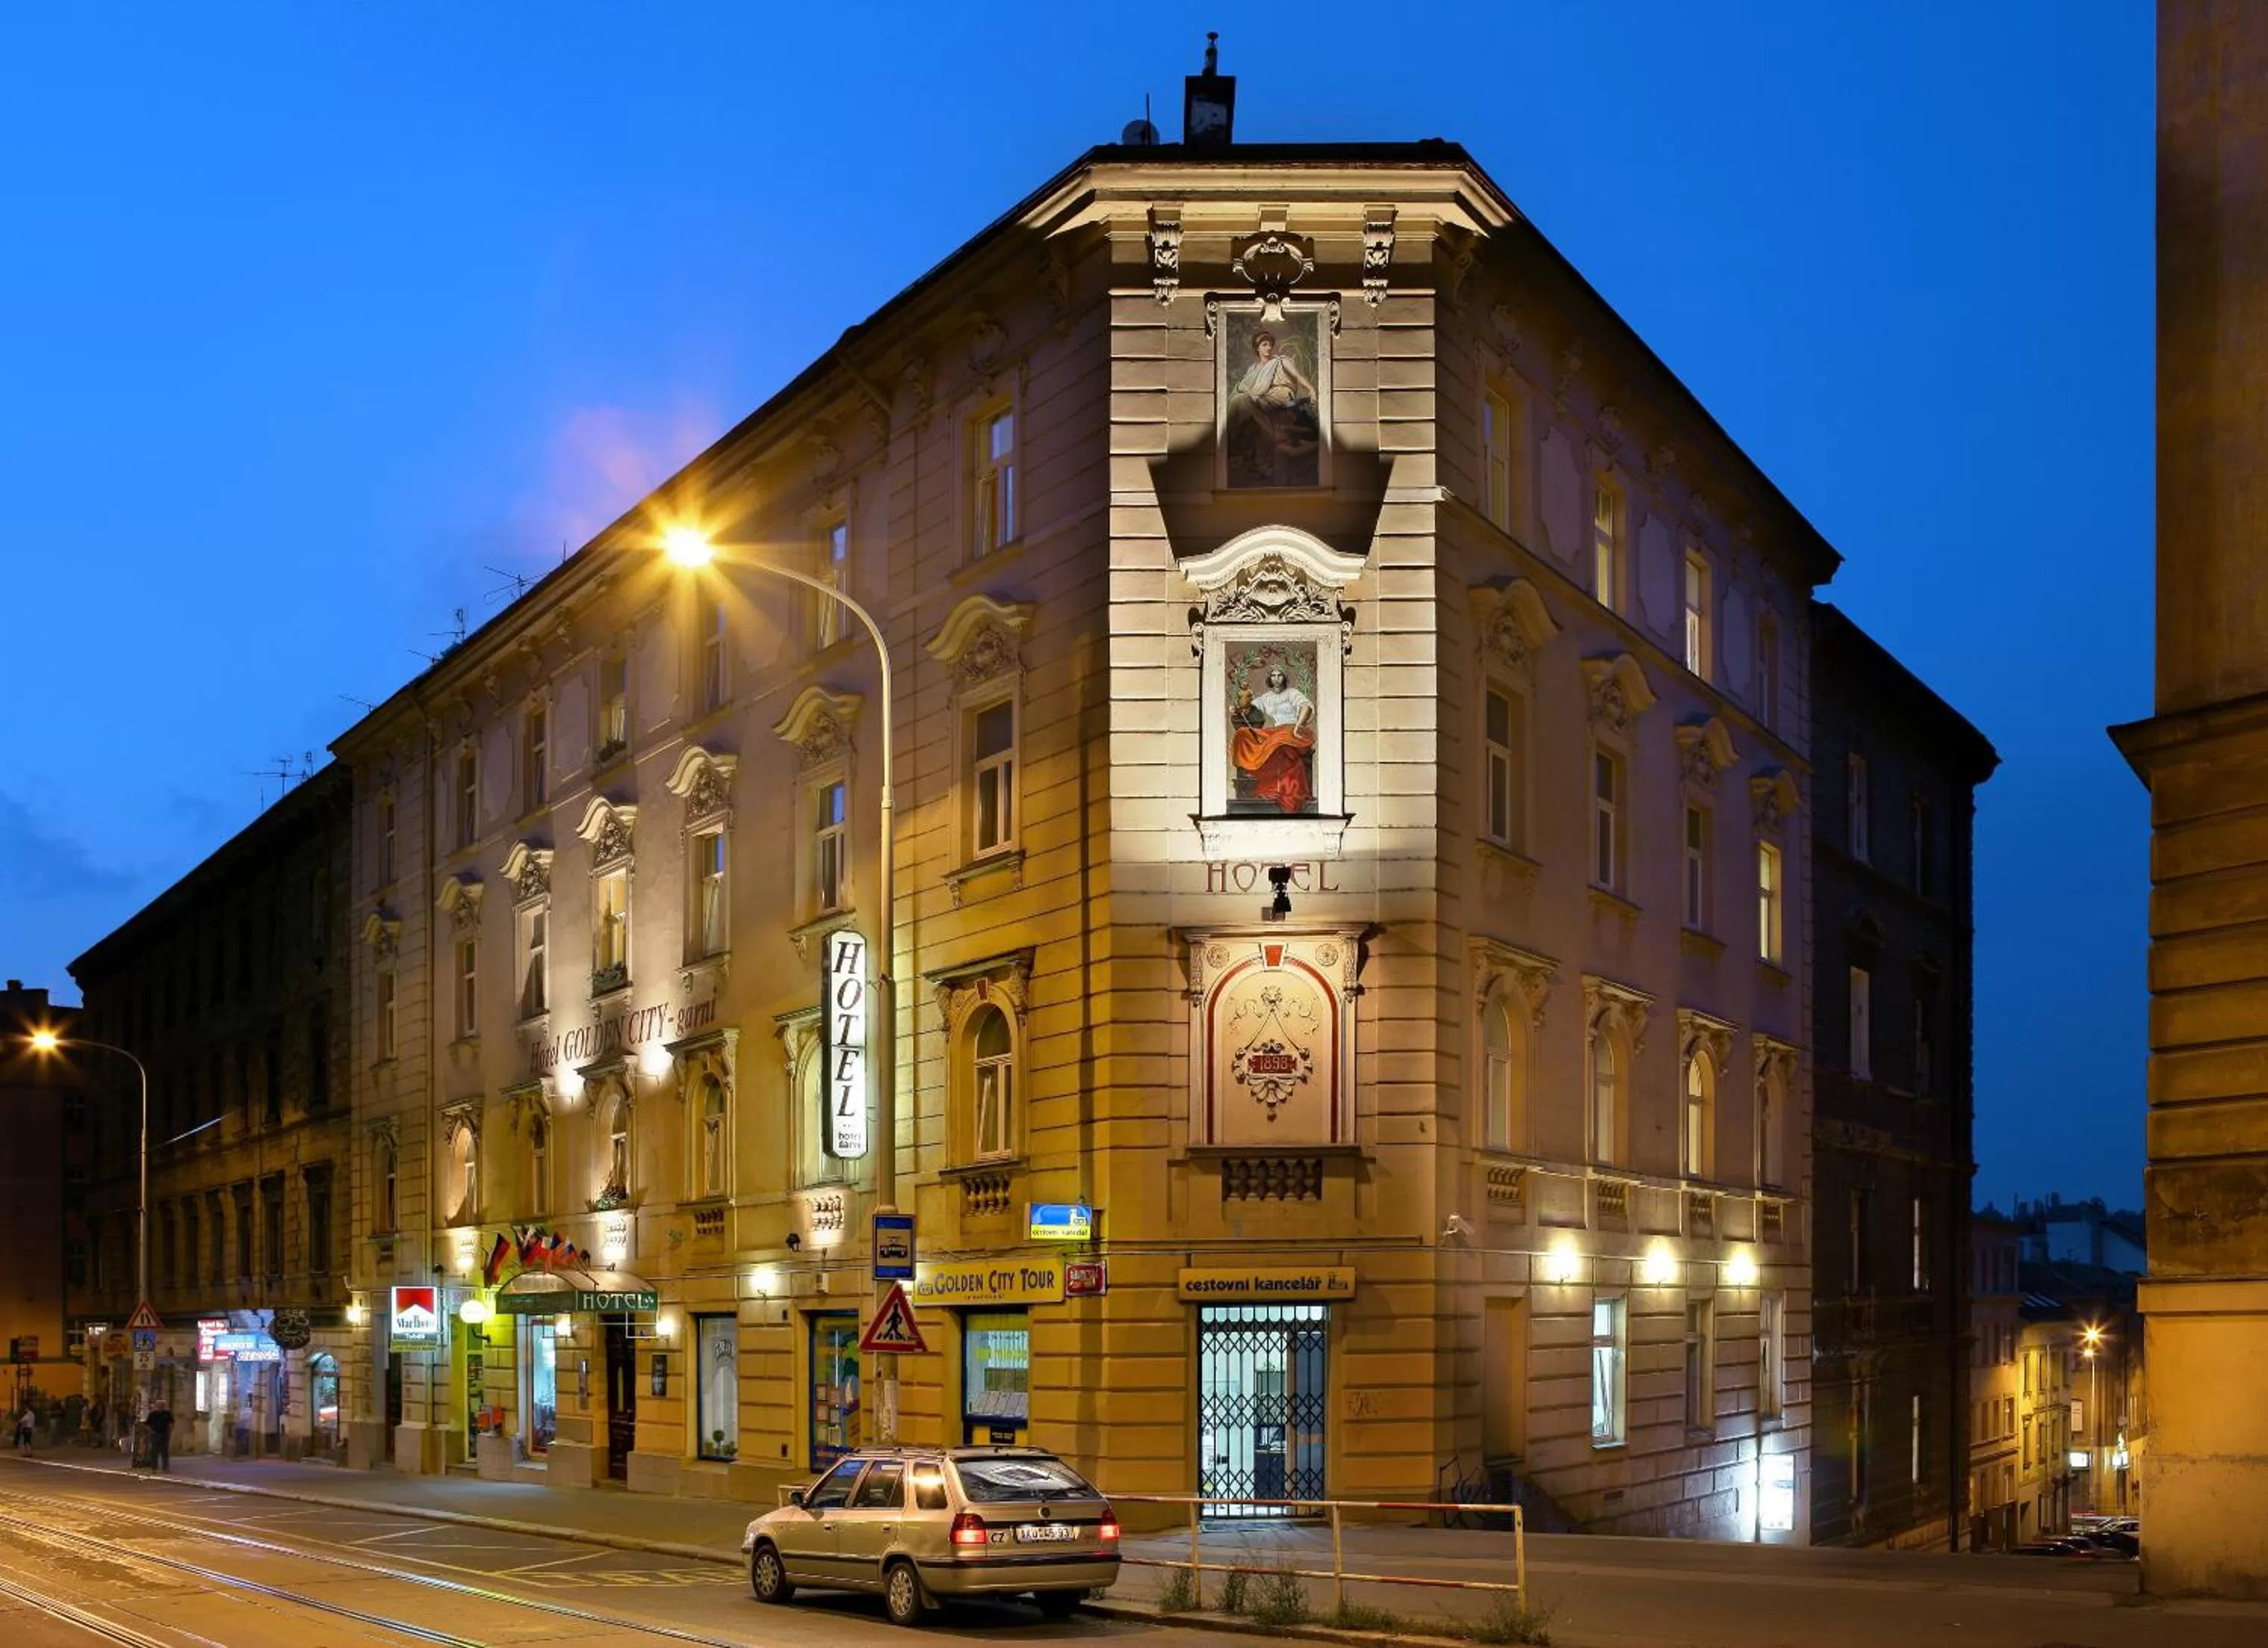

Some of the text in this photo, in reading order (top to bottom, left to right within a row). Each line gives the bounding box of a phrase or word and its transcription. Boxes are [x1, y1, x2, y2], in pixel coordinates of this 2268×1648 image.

[1205, 862, 1340, 894] HOEL
[531, 1035, 559, 1074] Hotel
[564, 1016, 624, 1061] GOLDEN
[628, 1002, 669, 1045] CITY
[833, 941, 863, 1117] HOTEL
[934, 1272, 984, 1295] GOLDEN
[989, 1269, 1015, 1293] CITY
[1021, 1268, 1055, 1291] TOUR
[1254, 1275, 1322, 1291] kancelář
[583, 1293, 646, 1309] HOTEL
[991, 1532, 1005, 1543] CZ
